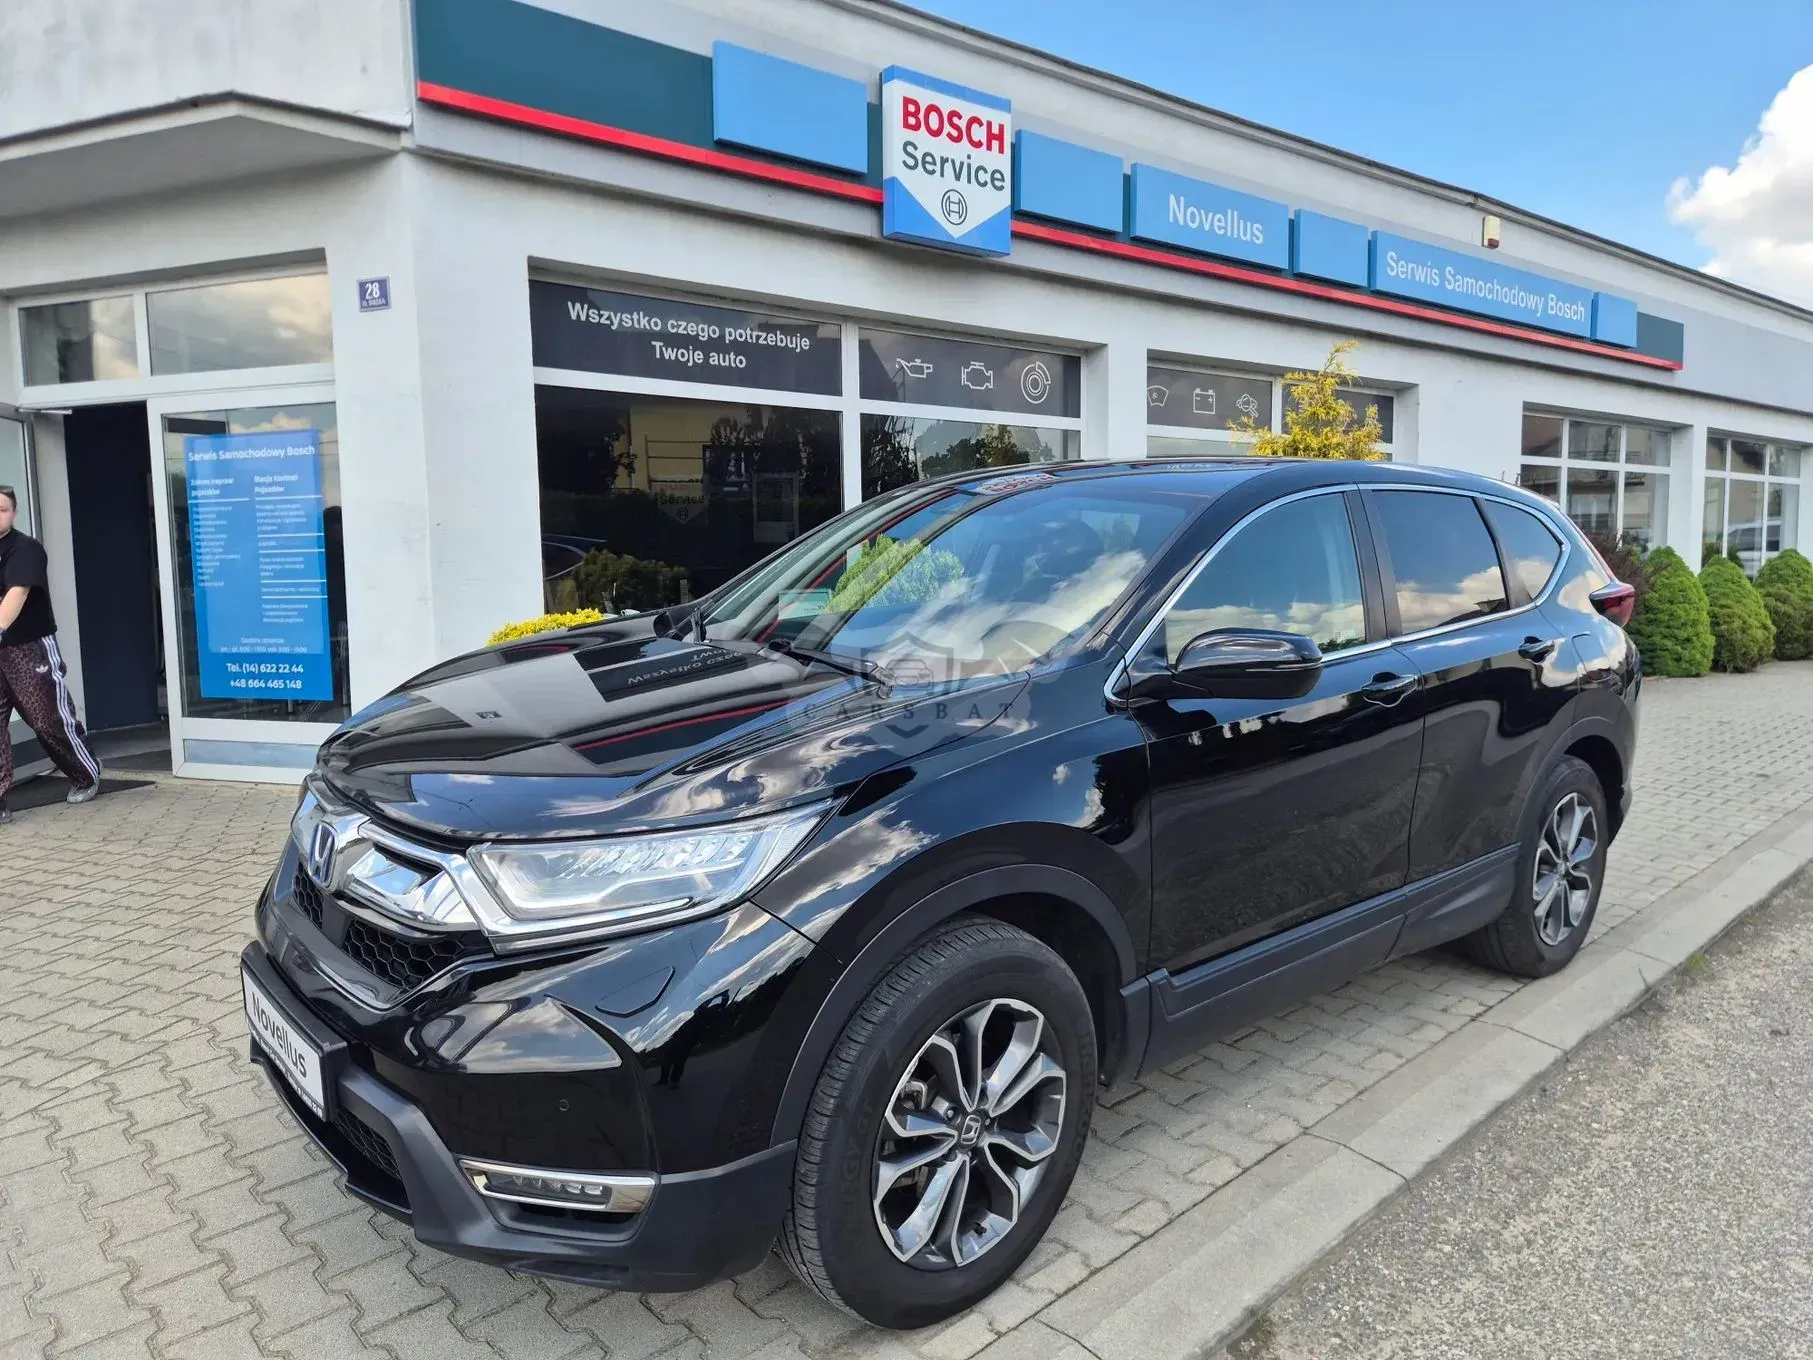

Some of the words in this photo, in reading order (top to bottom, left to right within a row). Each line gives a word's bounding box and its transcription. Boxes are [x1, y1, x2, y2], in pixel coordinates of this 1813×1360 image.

[902, 95, 1005, 155] BOSCH
[902, 140, 1006, 192] Service
[1168, 193, 1264, 245] Novellus
[365, 282, 380, 299] 28
[1386, 251, 1440, 286] Serwis
[1445, 266, 1544, 317] Samochodowy
[1548, 293, 1586, 322] Bosch
[567, 301, 662, 331] Wszystko
[667, 318, 720, 341] czego
[725, 324, 811, 352] potrzebuje
[651, 341, 704, 367] Twoje
[709, 351, 747, 369] auto
[188, 450, 218, 462] Serwis
[219, 447, 286, 460] Samochodowy
[287, 445, 315, 456] Bosch
[226, 663, 241, 673] Tel.
[242, 663, 259, 674] (14)
[260, 664, 277, 673] 622
[278, 664, 290, 673] 22
[291, 664, 304, 673] 44
[230, 679, 246, 688] +48
[247, 679, 265, 688] 664
[267, 680, 284, 689] 465
[286, 680, 302, 689] 148
[252, 991, 307, 1079] Novellus
